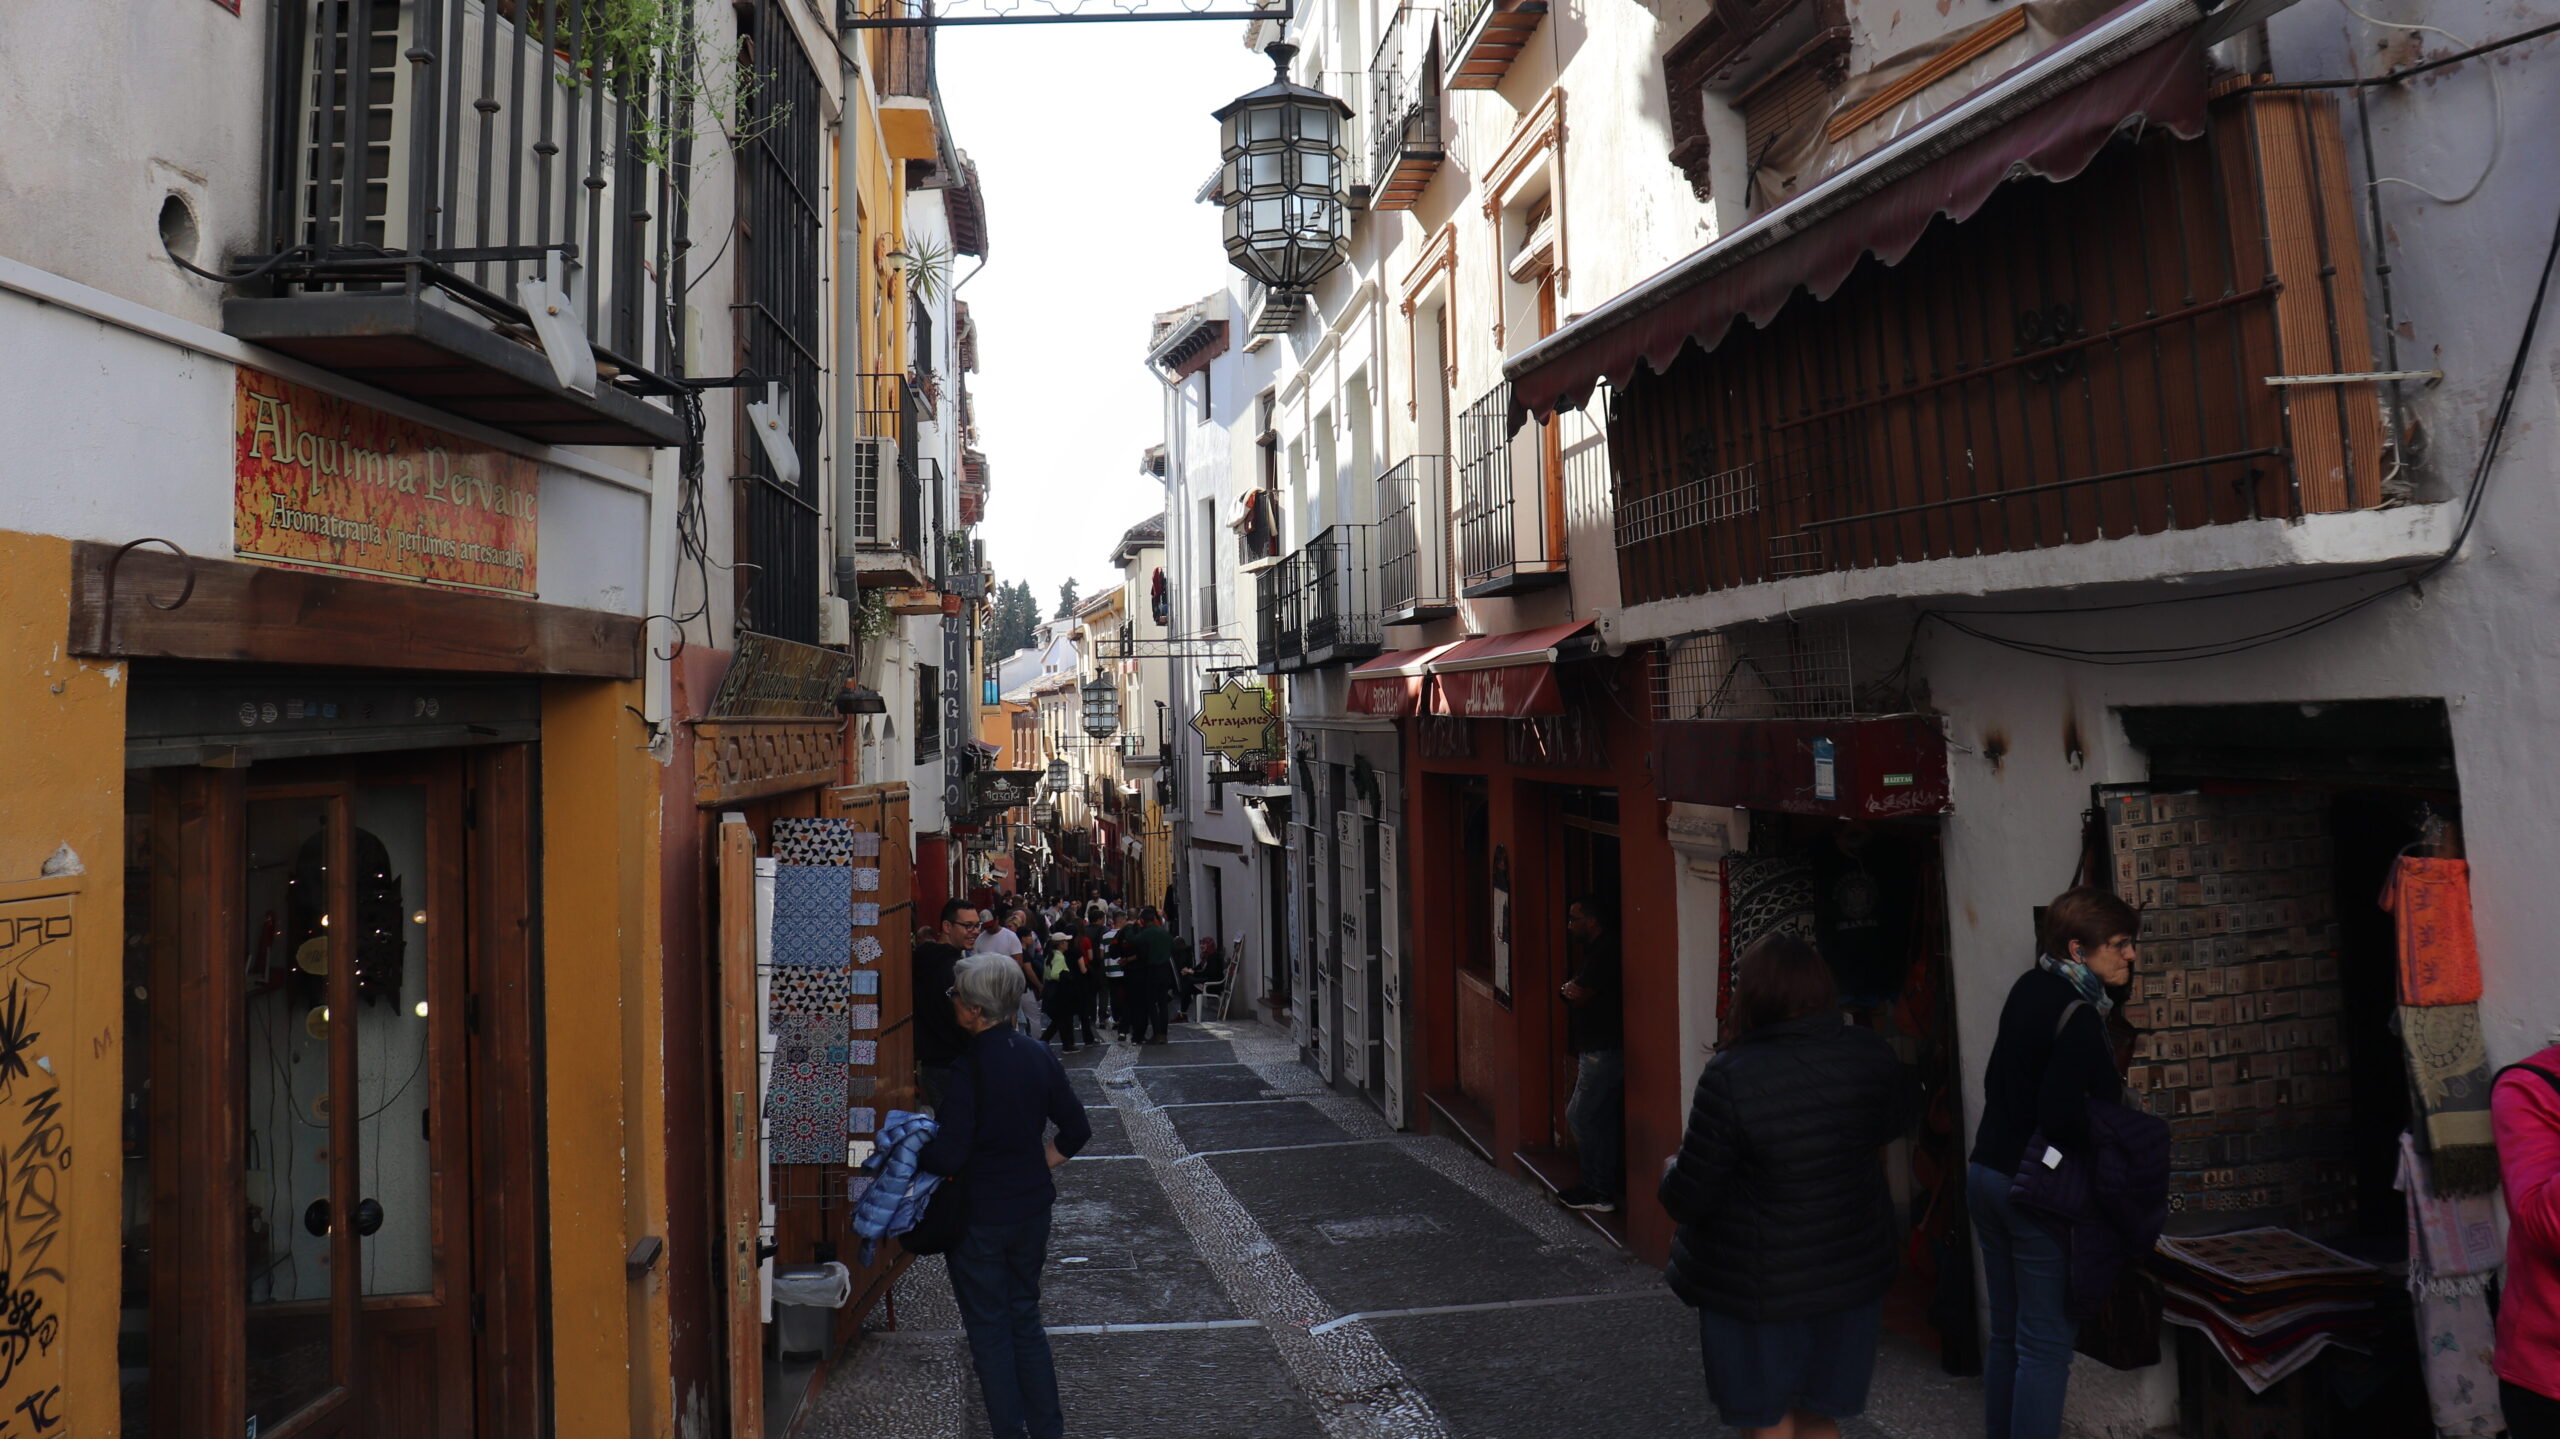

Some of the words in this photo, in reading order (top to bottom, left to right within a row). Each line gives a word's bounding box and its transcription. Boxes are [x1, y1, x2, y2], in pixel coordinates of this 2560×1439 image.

[248, 391, 416, 496] Alquimia
[424, 445, 537, 522] Pervane
[386, 530, 395, 558] y
[397, 525, 456, 562] perfumes
[459, 541, 526, 569] artesanales
[1200, 715, 1269, 728] Arrayanes
